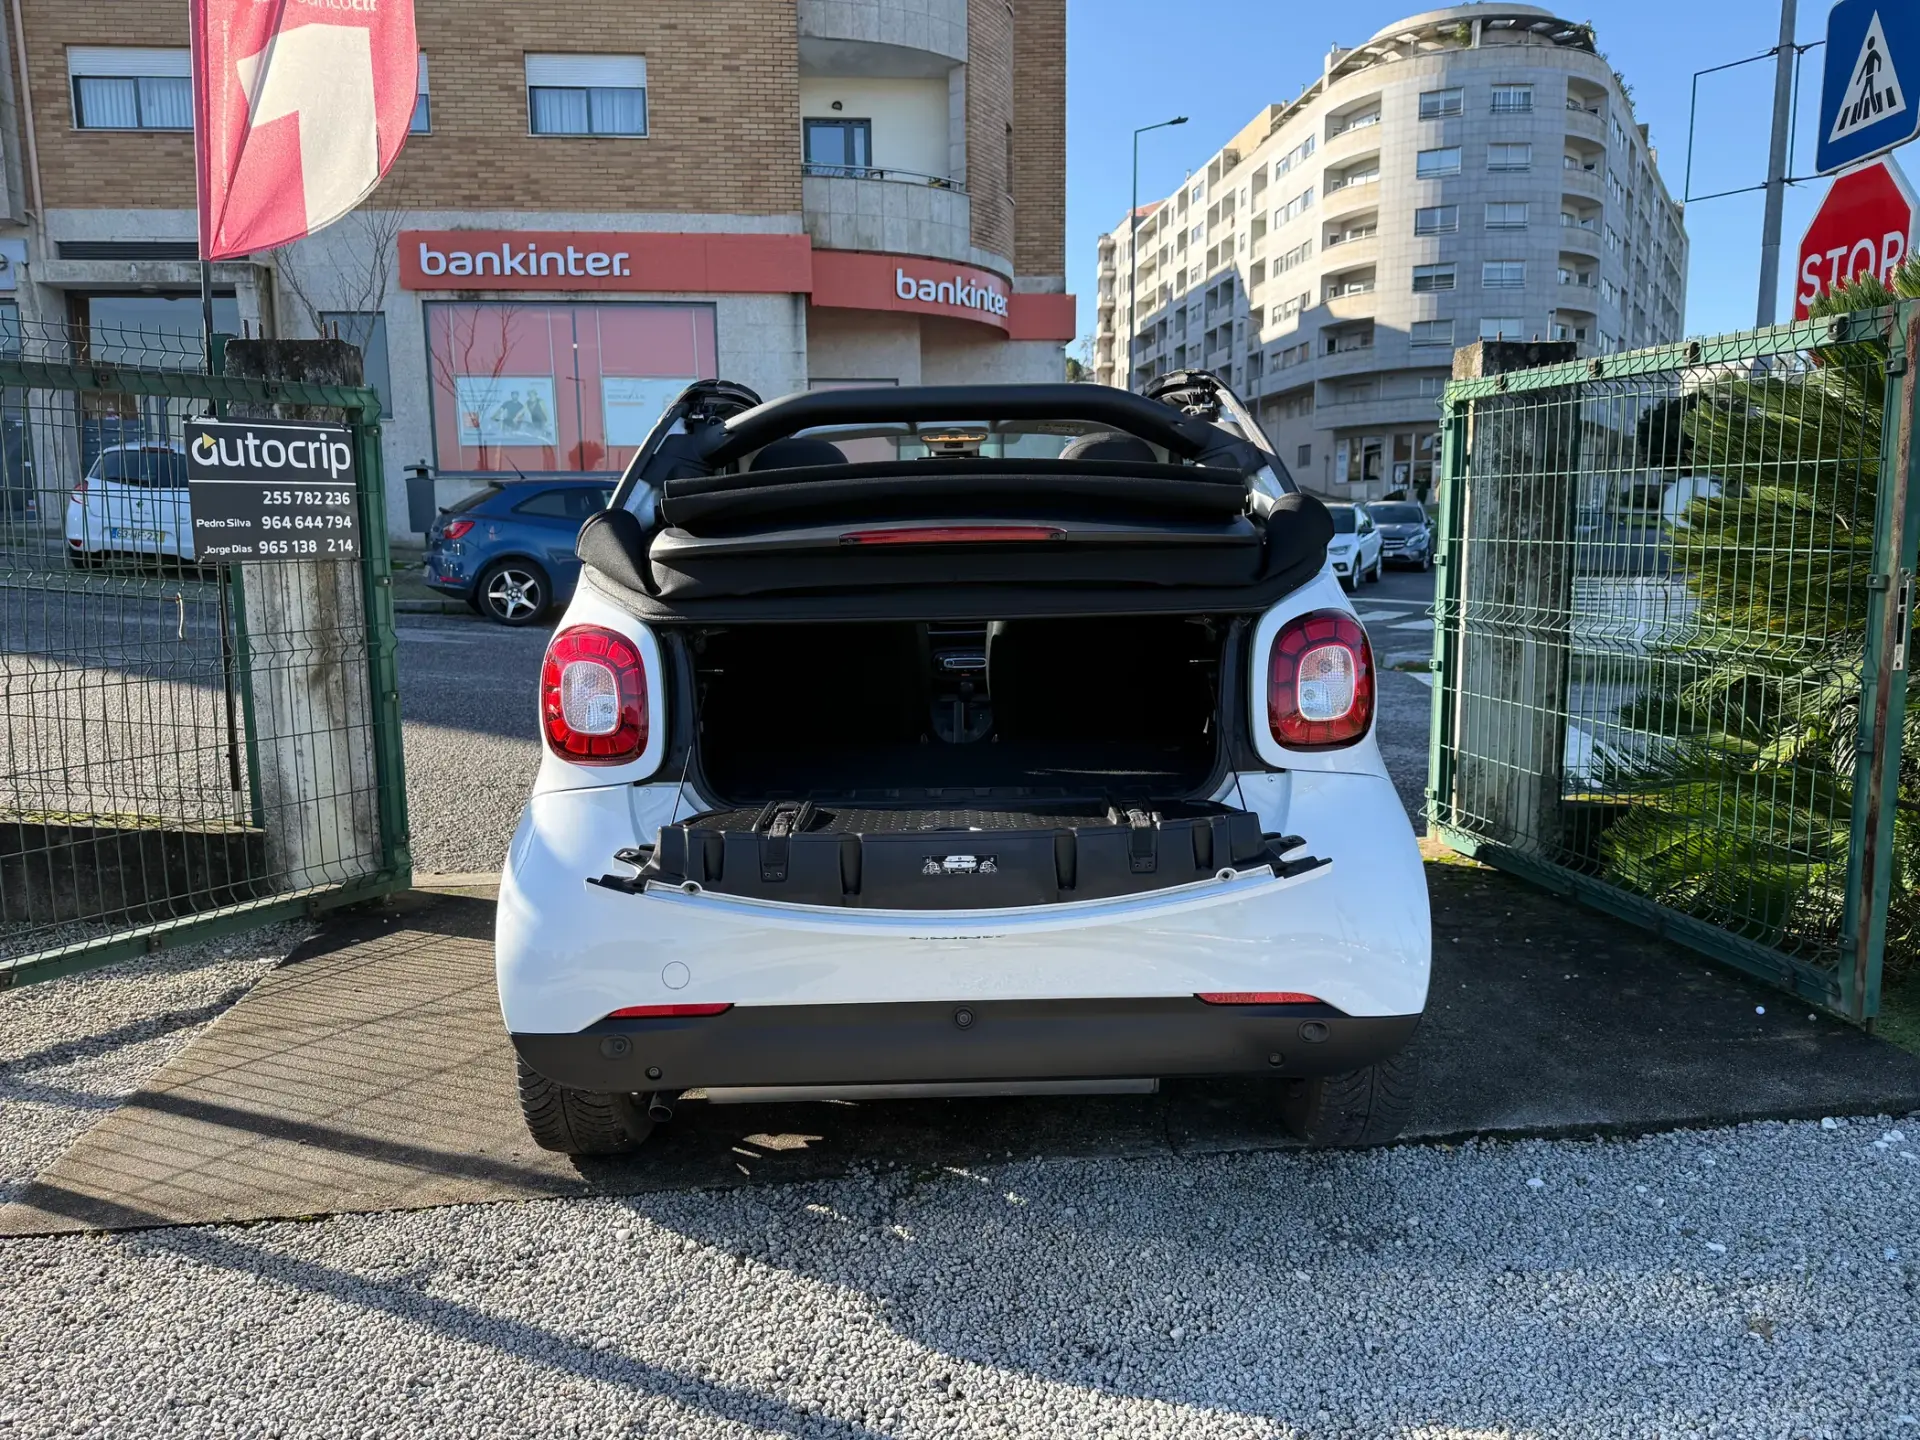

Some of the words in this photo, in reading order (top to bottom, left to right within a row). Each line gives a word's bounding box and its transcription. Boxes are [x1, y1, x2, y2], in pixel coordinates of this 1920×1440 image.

[419, 242, 631, 276] bankinter.
[1799, 230, 1905, 306] STOP
[191, 432, 351, 479] autocrip
[262, 491, 292, 505] 255
[294, 491, 323, 505] 782
[325, 491, 351, 505] 236
[196, 518, 226, 528] Pedro
[226, 518, 252, 528] Silva
[261, 516, 292, 529] 964
[294, 516, 324, 529] 644
[325, 515, 352, 529] 794
[204, 545, 231, 555] Jorge
[231, 544, 253, 553] Dias
[259, 541, 288, 554] 965
[291, 540, 318, 553] 138
